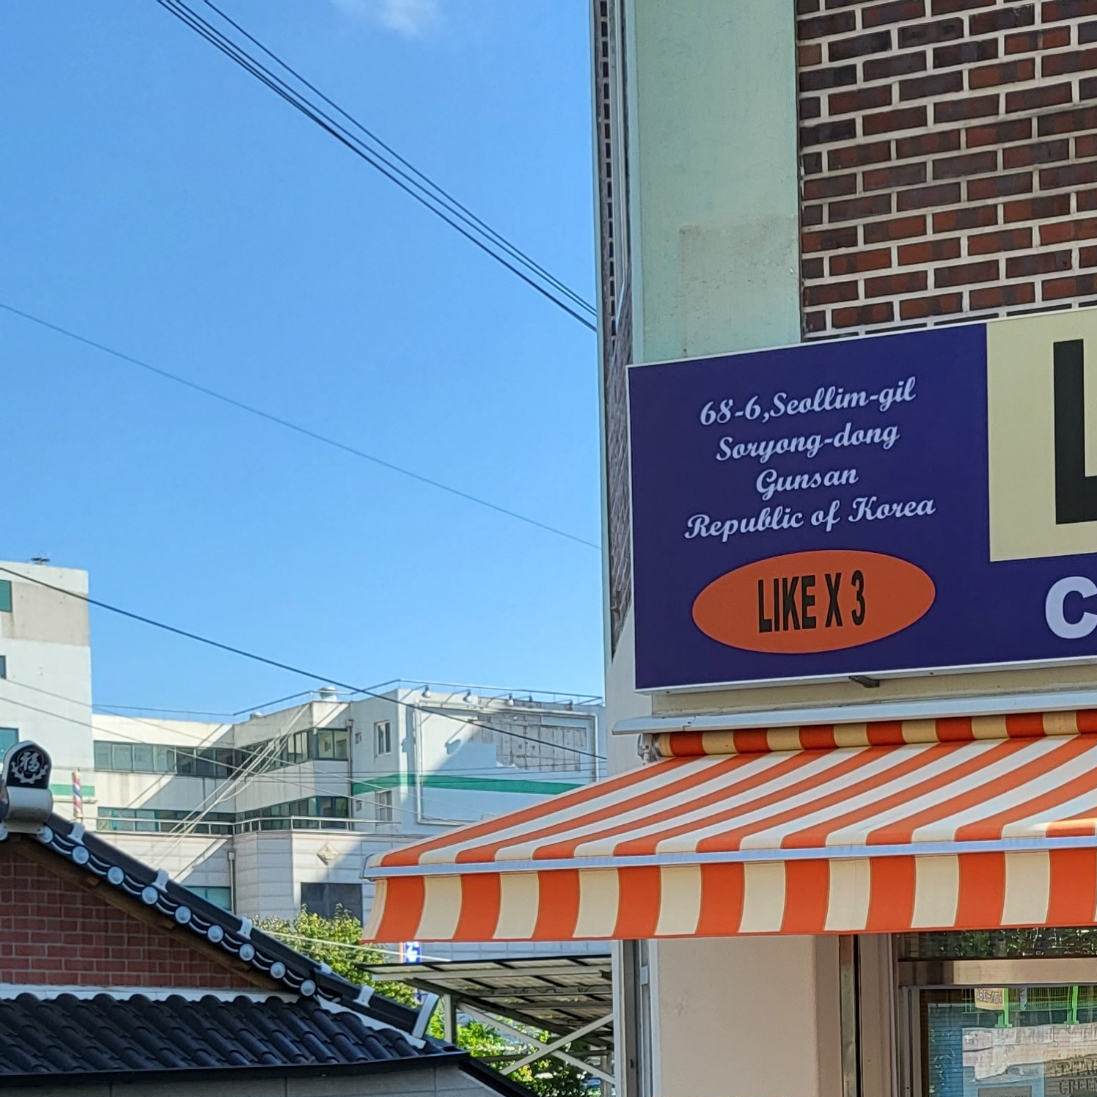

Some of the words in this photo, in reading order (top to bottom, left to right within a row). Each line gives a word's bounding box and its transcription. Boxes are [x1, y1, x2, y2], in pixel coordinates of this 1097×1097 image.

[716, 422, 899, 464] Soryong-dong
[756, 468, 858, 500] Gunsan
[684, 505, 804, 542] Republic
[810, 500, 840, 531] of
[848, 496, 936, 522] Korea
[758, 574, 817, 633] LIKE
[824, 572, 843, 628] X
[851, 570, 866, 625] 3
